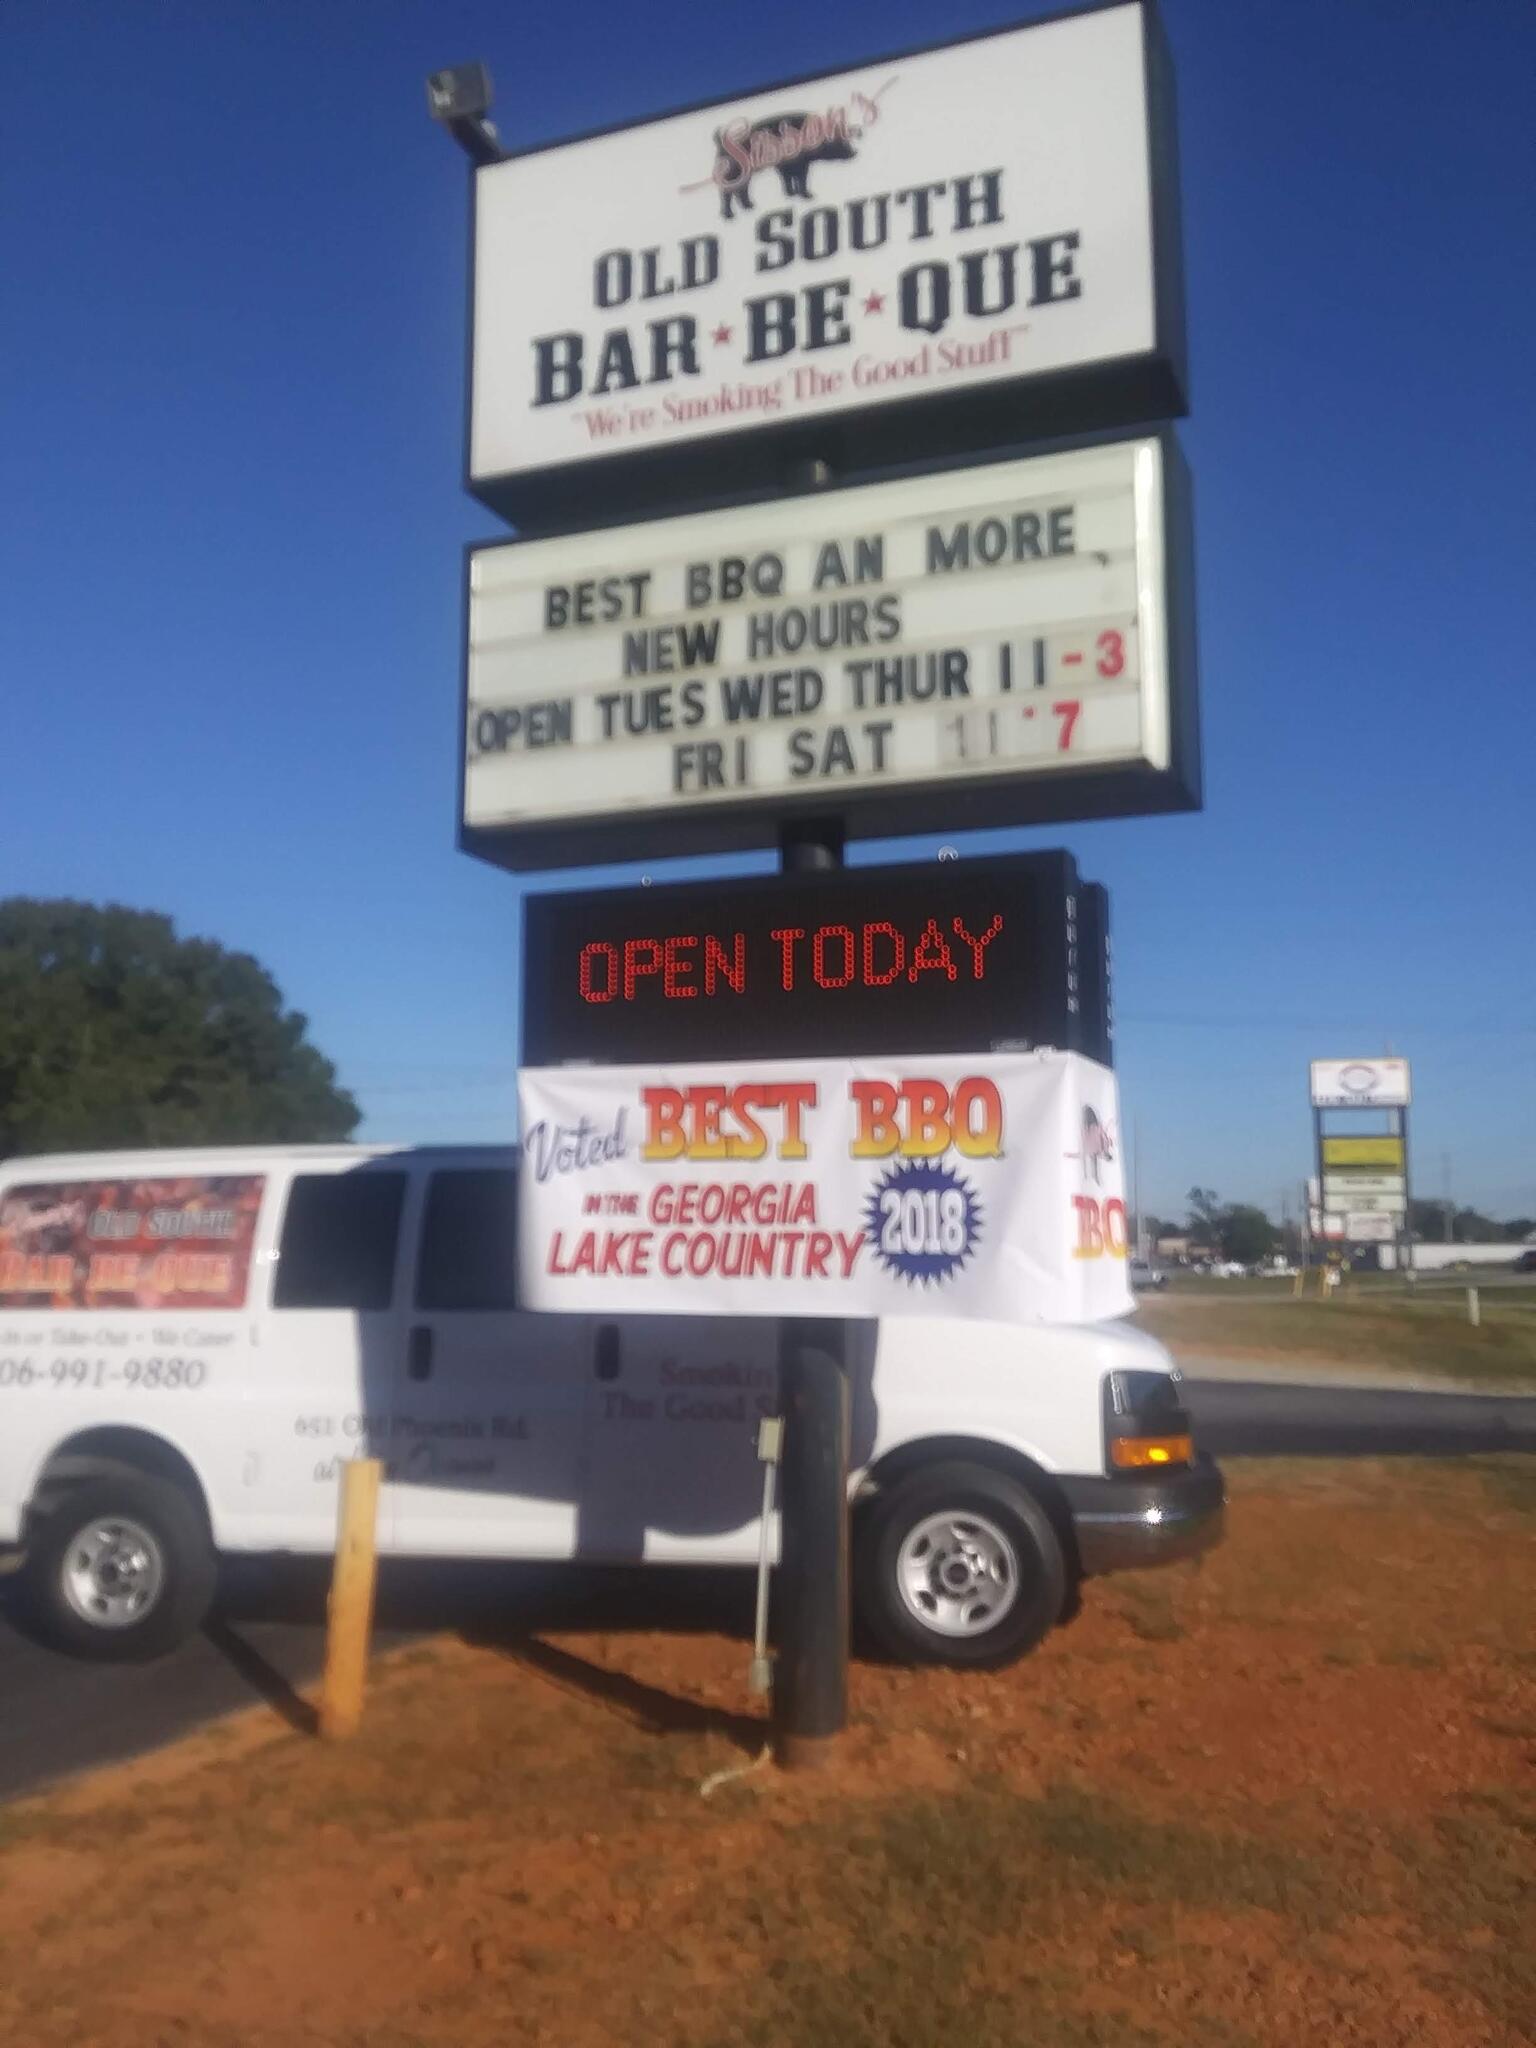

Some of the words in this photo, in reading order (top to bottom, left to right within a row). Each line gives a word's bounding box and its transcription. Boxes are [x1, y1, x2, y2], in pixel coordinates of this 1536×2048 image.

[593, 236, 720, 309] OLD
[756, 168, 1005, 273] SOUTH
[530, 313, 701, 408] BAR
[743, 277, 853, 365] BE
[901, 230, 1084, 335] QUE
[662, 379, 784, 423] Smoking
[787, 364, 844, 398] The
[851, 343, 930, 387] Good
[545, 571, 652, 632] BEST
[685, 552, 785, 609] BBQ
[814, 534, 886, 589] AN
[926, 506, 1077, 573] MORE
[622, 618, 720, 678] NEW
[748, 594, 902, 660] HOURS
[475, 704, 574, 754] OPEN
[598, 682, 706, 741] TUES
[719, 668, 825, 723] WED
[844, 647, 971, 709] THUR
[672, 738, 750, 796] FRI
[787, 722, 895, 779] SAT
[580, 933, 745, 1002] OPEN
[771, 914, 1003, 992] TODAY
[523, 1106, 629, 1184] Voted
[640, 1080, 818, 1161] BEST
[848, 1075, 1006, 1161] BBQ
[650, 1182, 819, 1226] GEORGIA
[879, 1187, 968, 1257] 2018
[547, 1230, 655, 1277] LAKE
[659, 1230, 868, 1279] COUNTRY
